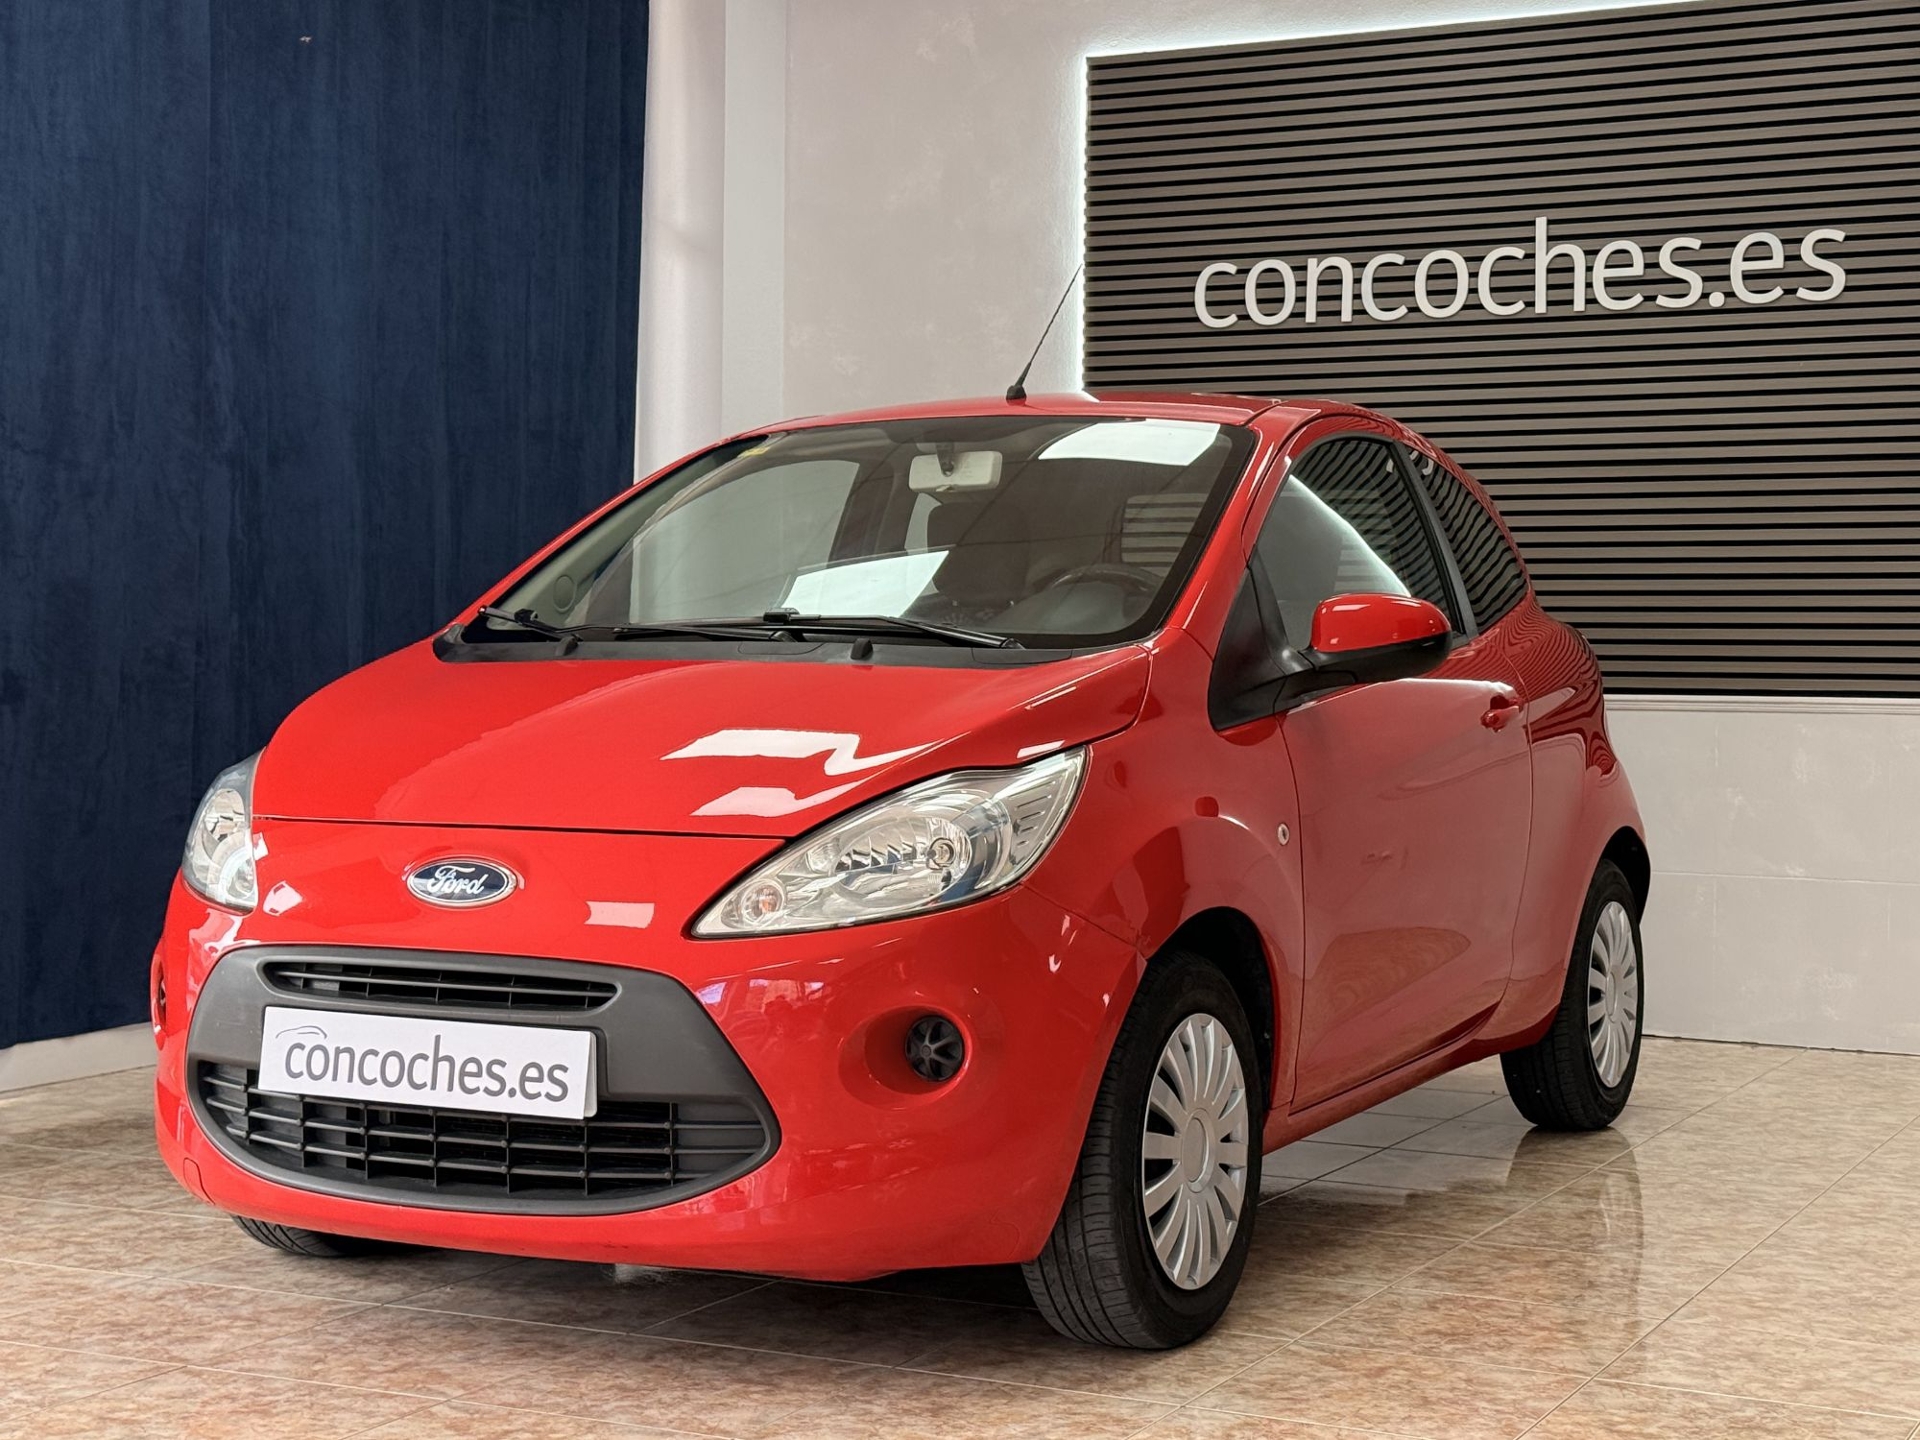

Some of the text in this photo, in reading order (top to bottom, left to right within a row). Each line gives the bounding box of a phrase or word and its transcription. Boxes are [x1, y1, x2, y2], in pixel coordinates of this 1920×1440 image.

[1193, 216, 1847, 329] concoches.es
[427, 865, 489, 895] Ford
[285, 1035, 569, 1102] concoches.es
